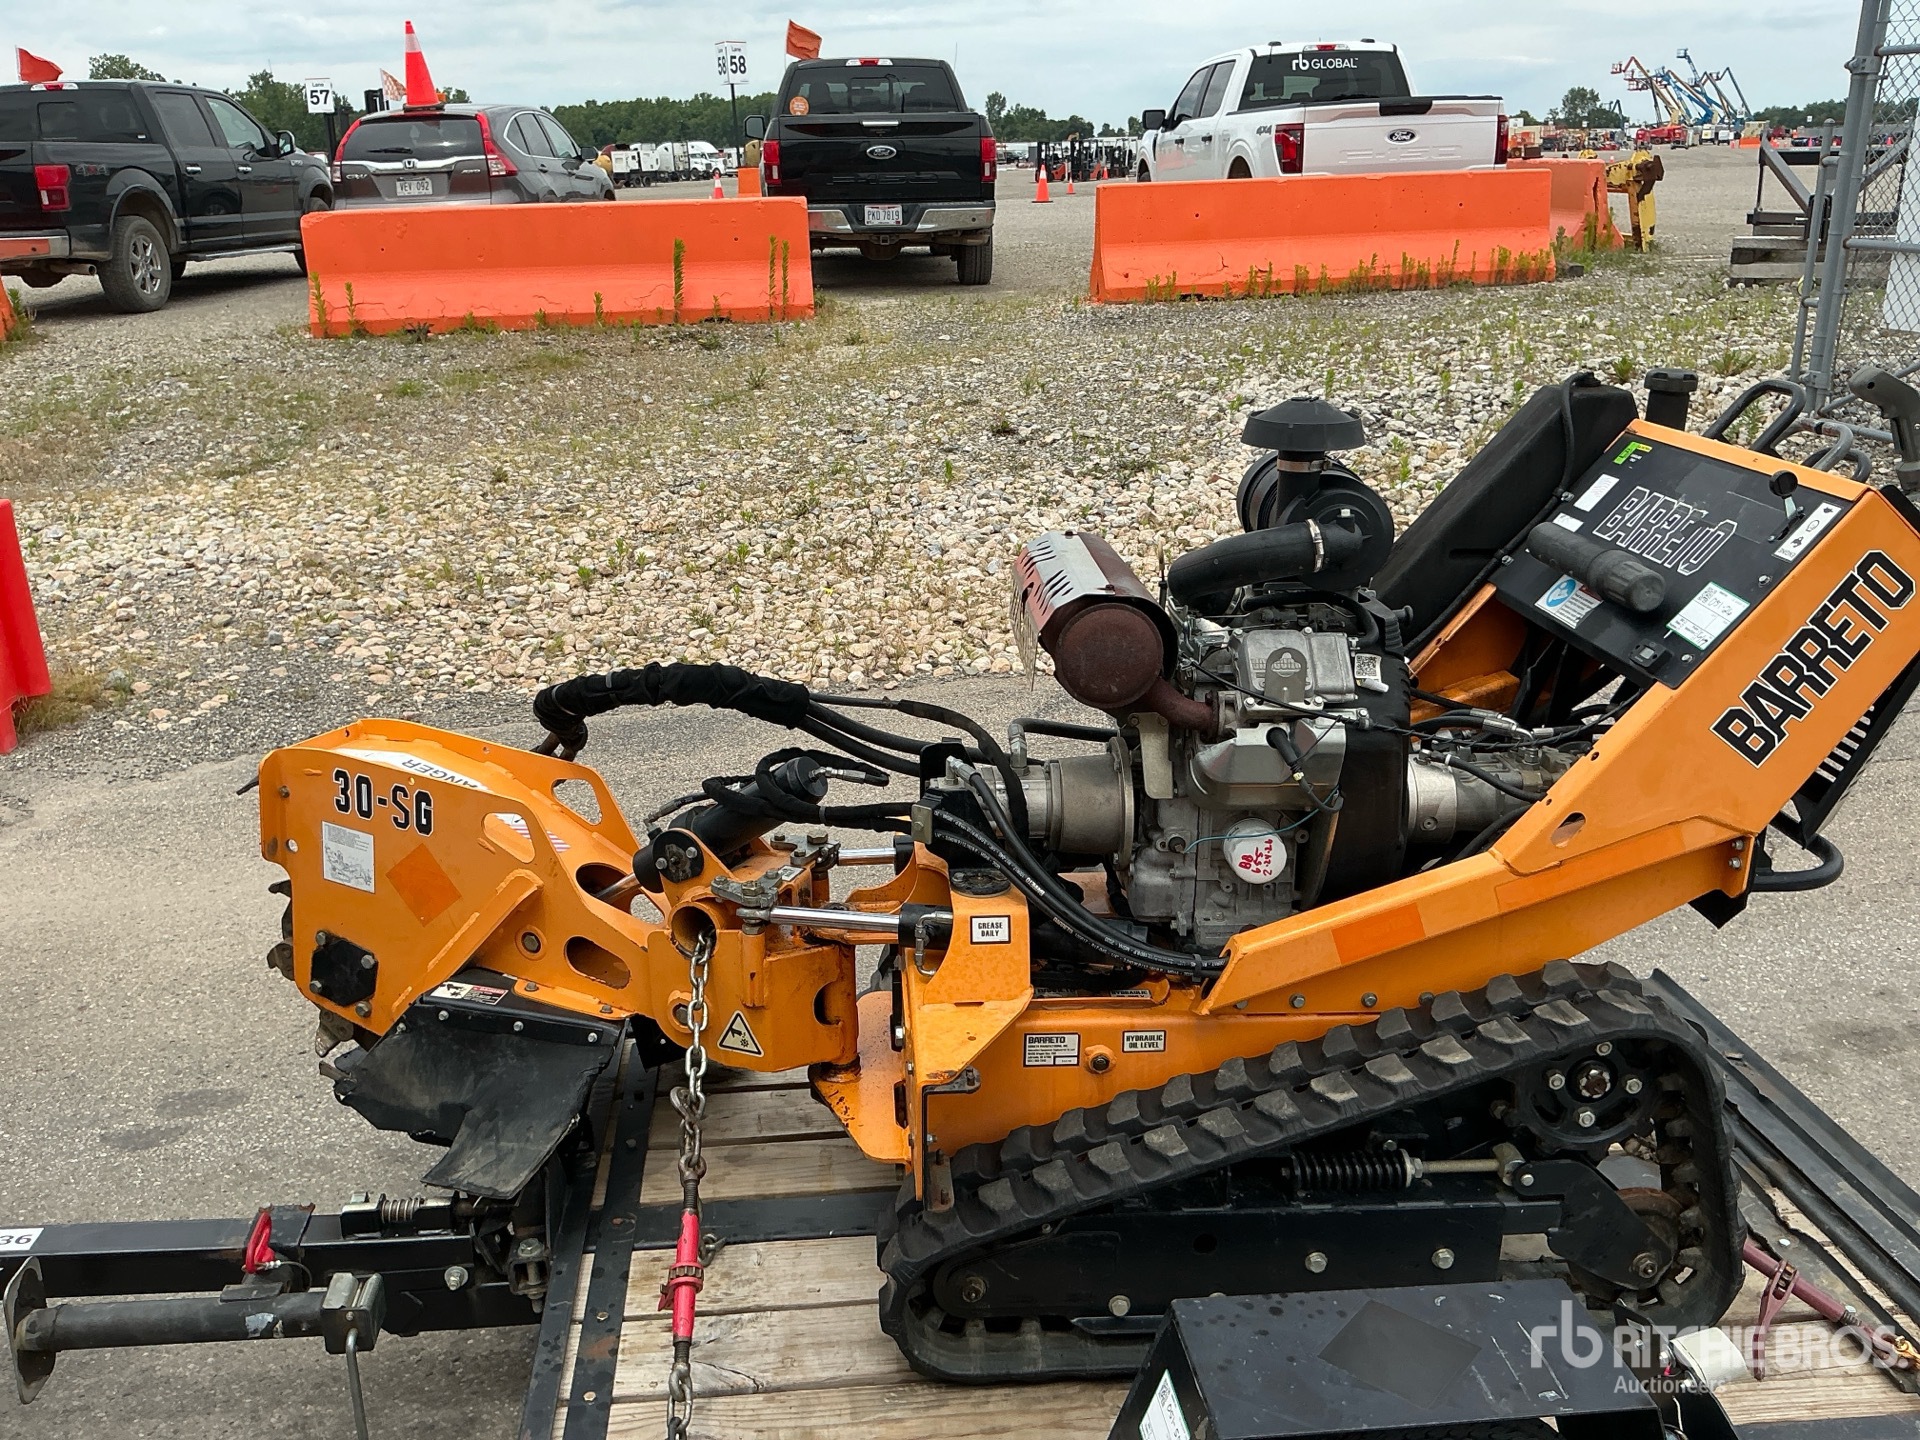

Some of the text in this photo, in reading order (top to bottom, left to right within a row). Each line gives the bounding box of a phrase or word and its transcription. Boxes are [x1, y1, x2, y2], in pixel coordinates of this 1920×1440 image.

[717, 55, 727, 75] 58
[729, 55, 747, 74] 58
[1292, 53, 1357, 71] rb GLOBAL
[310, 89, 330, 105] 57
[1392, 130, 1412, 142] Ford
[416, 180, 430, 191] 092
[882, 210, 900, 221] 7819
[1709, 549, 1916, 769] BARRETO
[333, 767, 434, 837] 30-SG
[977, 922, 1004, 930] GREASE
[1028, 1036, 1066, 1044] BARRETO
[1140, 1041, 1160, 1049] LEVEL
